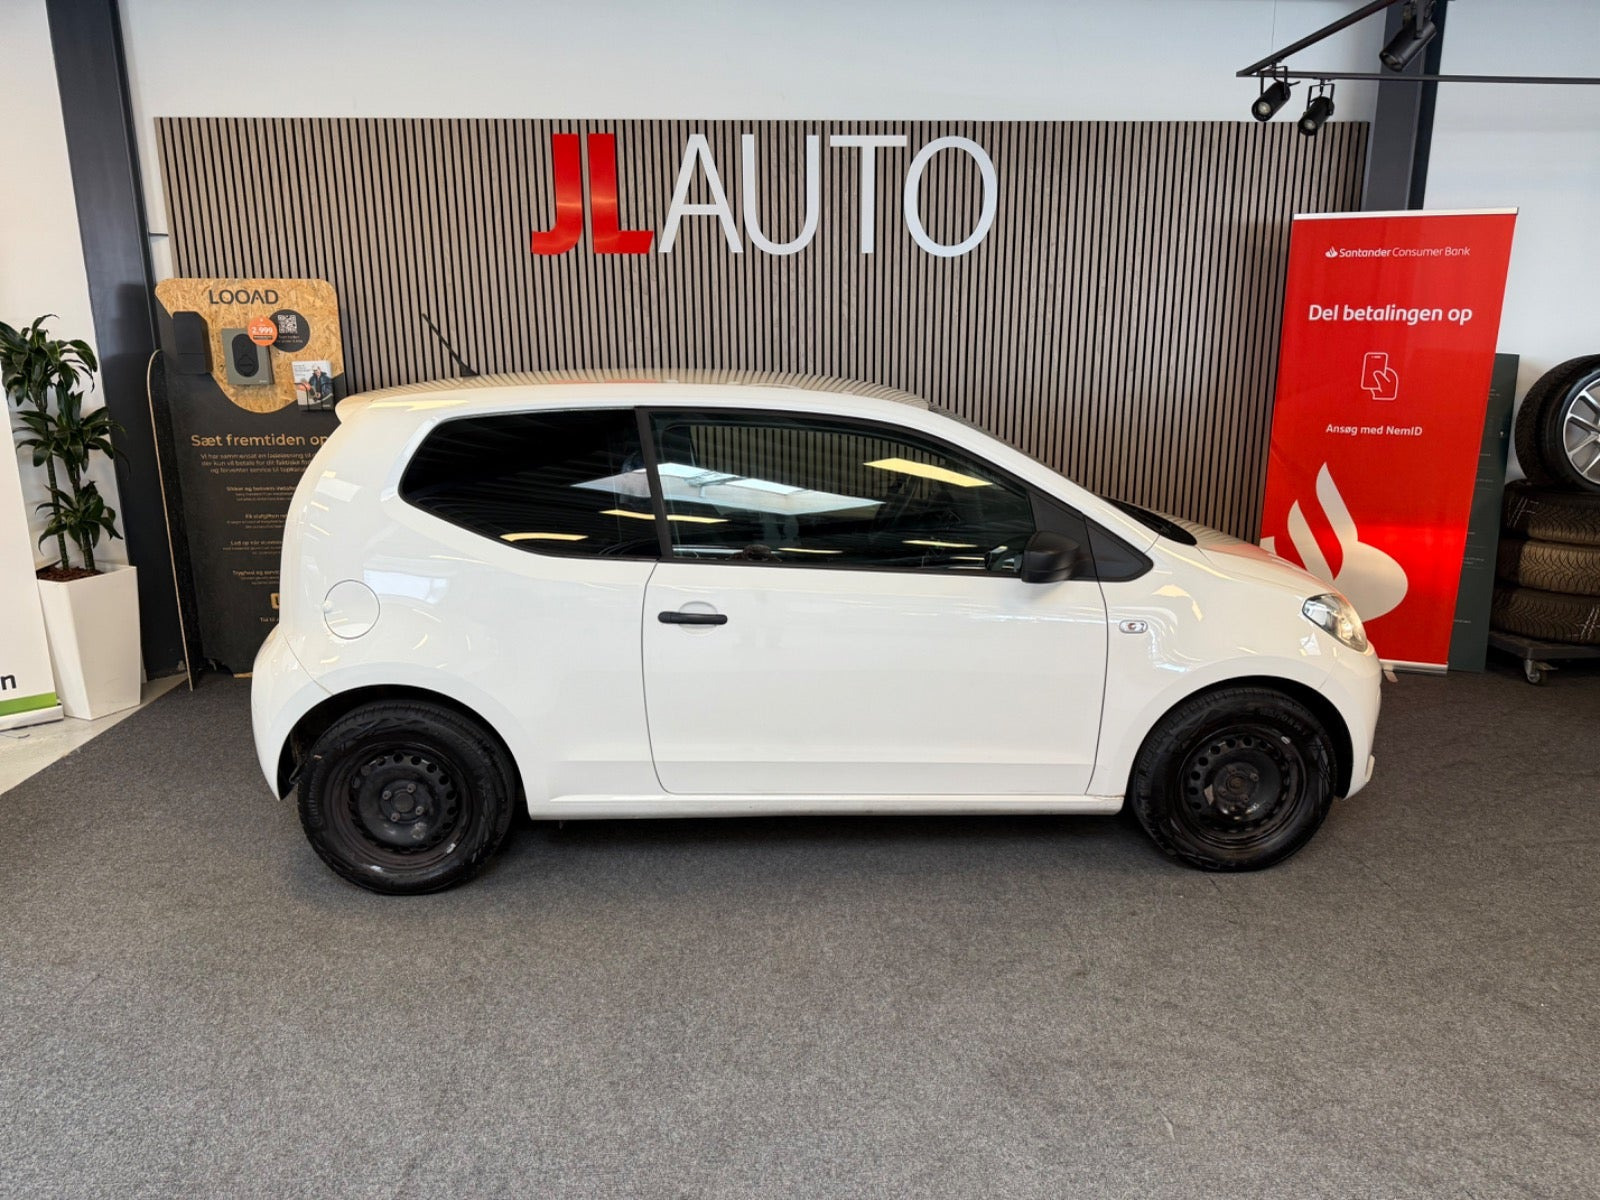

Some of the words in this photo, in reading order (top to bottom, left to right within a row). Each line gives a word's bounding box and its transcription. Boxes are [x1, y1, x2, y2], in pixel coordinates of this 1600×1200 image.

[1339, 247, 1391, 258] Santander
[1392, 247, 1443, 257] Consumer
[1444, 246, 1471, 257] Bank
[208, 289, 279, 305] LOOAD
[1308, 304, 1339, 322] Del
[1343, 304, 1443, 326] betalingen
[1447, 307, 1473, 326] op
[1326, 424, 1358, 437] Ansøg
[1360, 425, 1384, 435] med
[1385, 426, 1423, 436] NemID
[191, 434, 223, 447] Sæt
[226, 433, 306, 447] fremtiden
